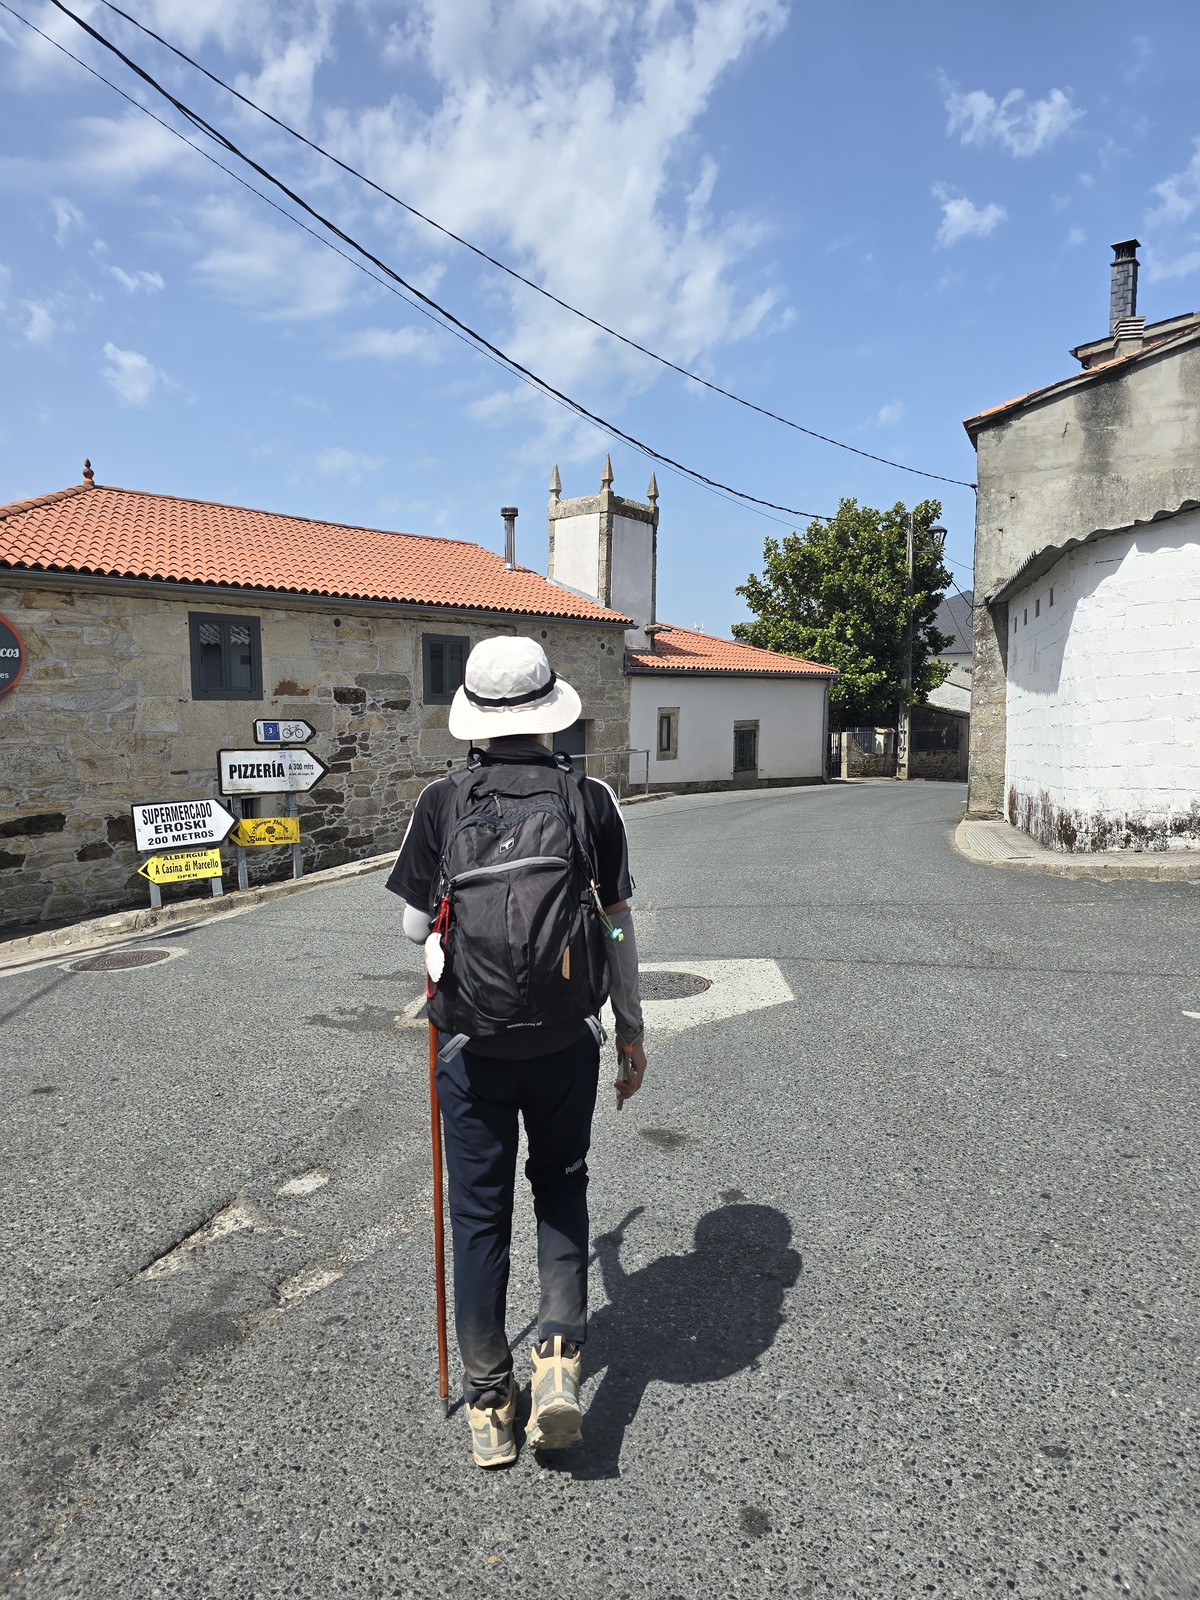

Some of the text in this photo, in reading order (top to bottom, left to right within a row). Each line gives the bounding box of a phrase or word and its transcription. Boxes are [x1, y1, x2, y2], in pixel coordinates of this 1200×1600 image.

[229, 760, 285, 779] PIZZERÍA
[142, 802, 212, 825] SUPERMERCADO
[154, 820, 206, 834] EROSKI
[147, 830, 214, 845] 200 METROS
[163, 852, 208, 861] ALBERGUE
[155, 859, 218, 875] A Casina di Marcello
